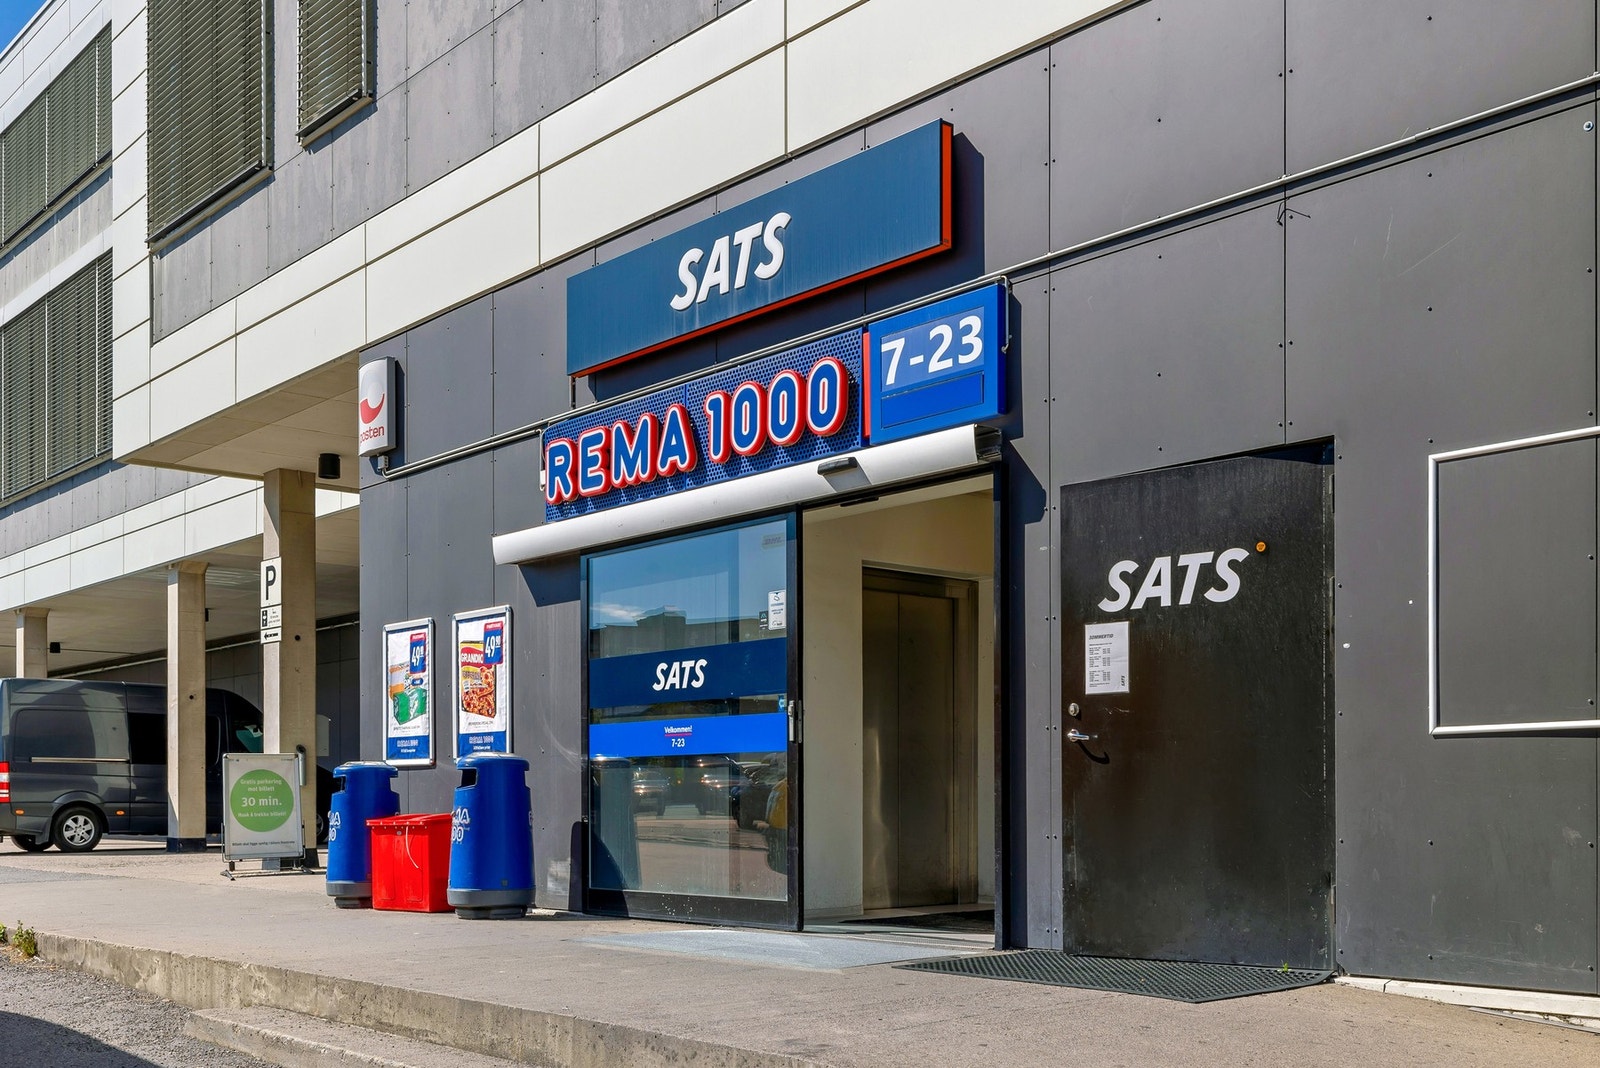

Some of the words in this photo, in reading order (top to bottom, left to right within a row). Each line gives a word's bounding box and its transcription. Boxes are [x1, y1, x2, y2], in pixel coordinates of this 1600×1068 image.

[670, 212, 791, 311] SATS
[881, 315, 983, 386] 7-23
[546, 404, 697, 504] REMA
[705, 357, 848, 464] 1000
[265, 564, 277, 600] P
[1097, 548, 1250, 612] SATS
[652, 659, 708, 691] SATS
[664, 725, 692, 734] Velkommen!
[671, 738, 685, 747] 7-23
[241, 797, 256, 807] 30
[259, 796, 282, 806] min.
